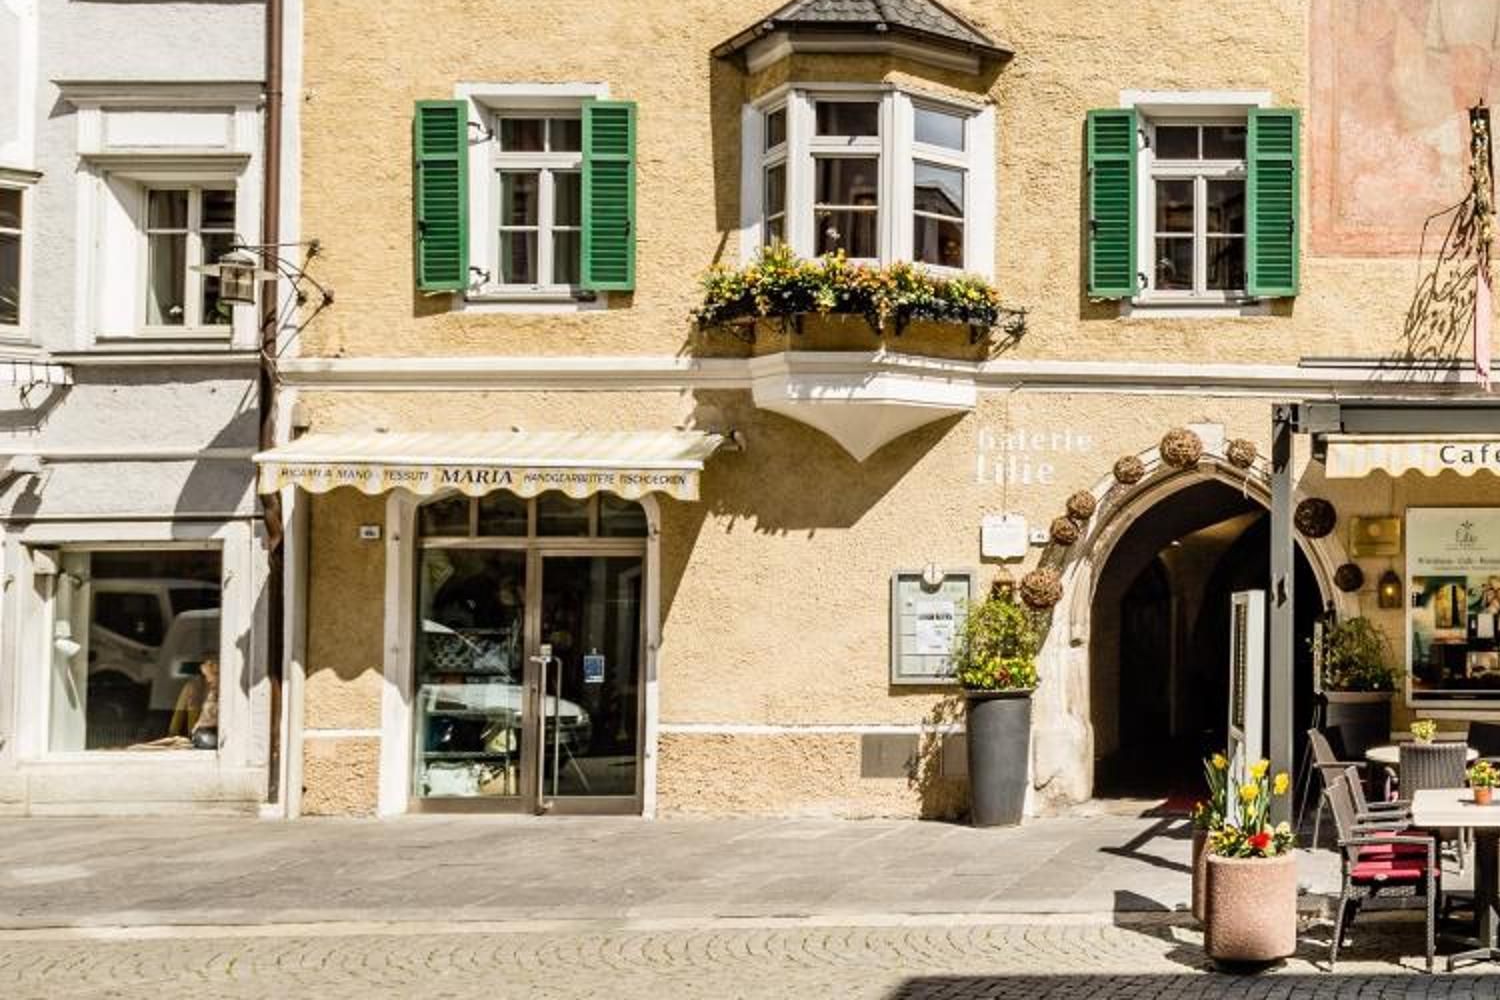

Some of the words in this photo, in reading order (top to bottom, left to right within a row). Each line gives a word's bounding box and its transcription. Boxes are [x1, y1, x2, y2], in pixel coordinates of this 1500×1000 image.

[335, 469, 372, 480] MANO
[384, 470, 429, 480] TESSUTI
[440, 469, 513, 484] MARIA
